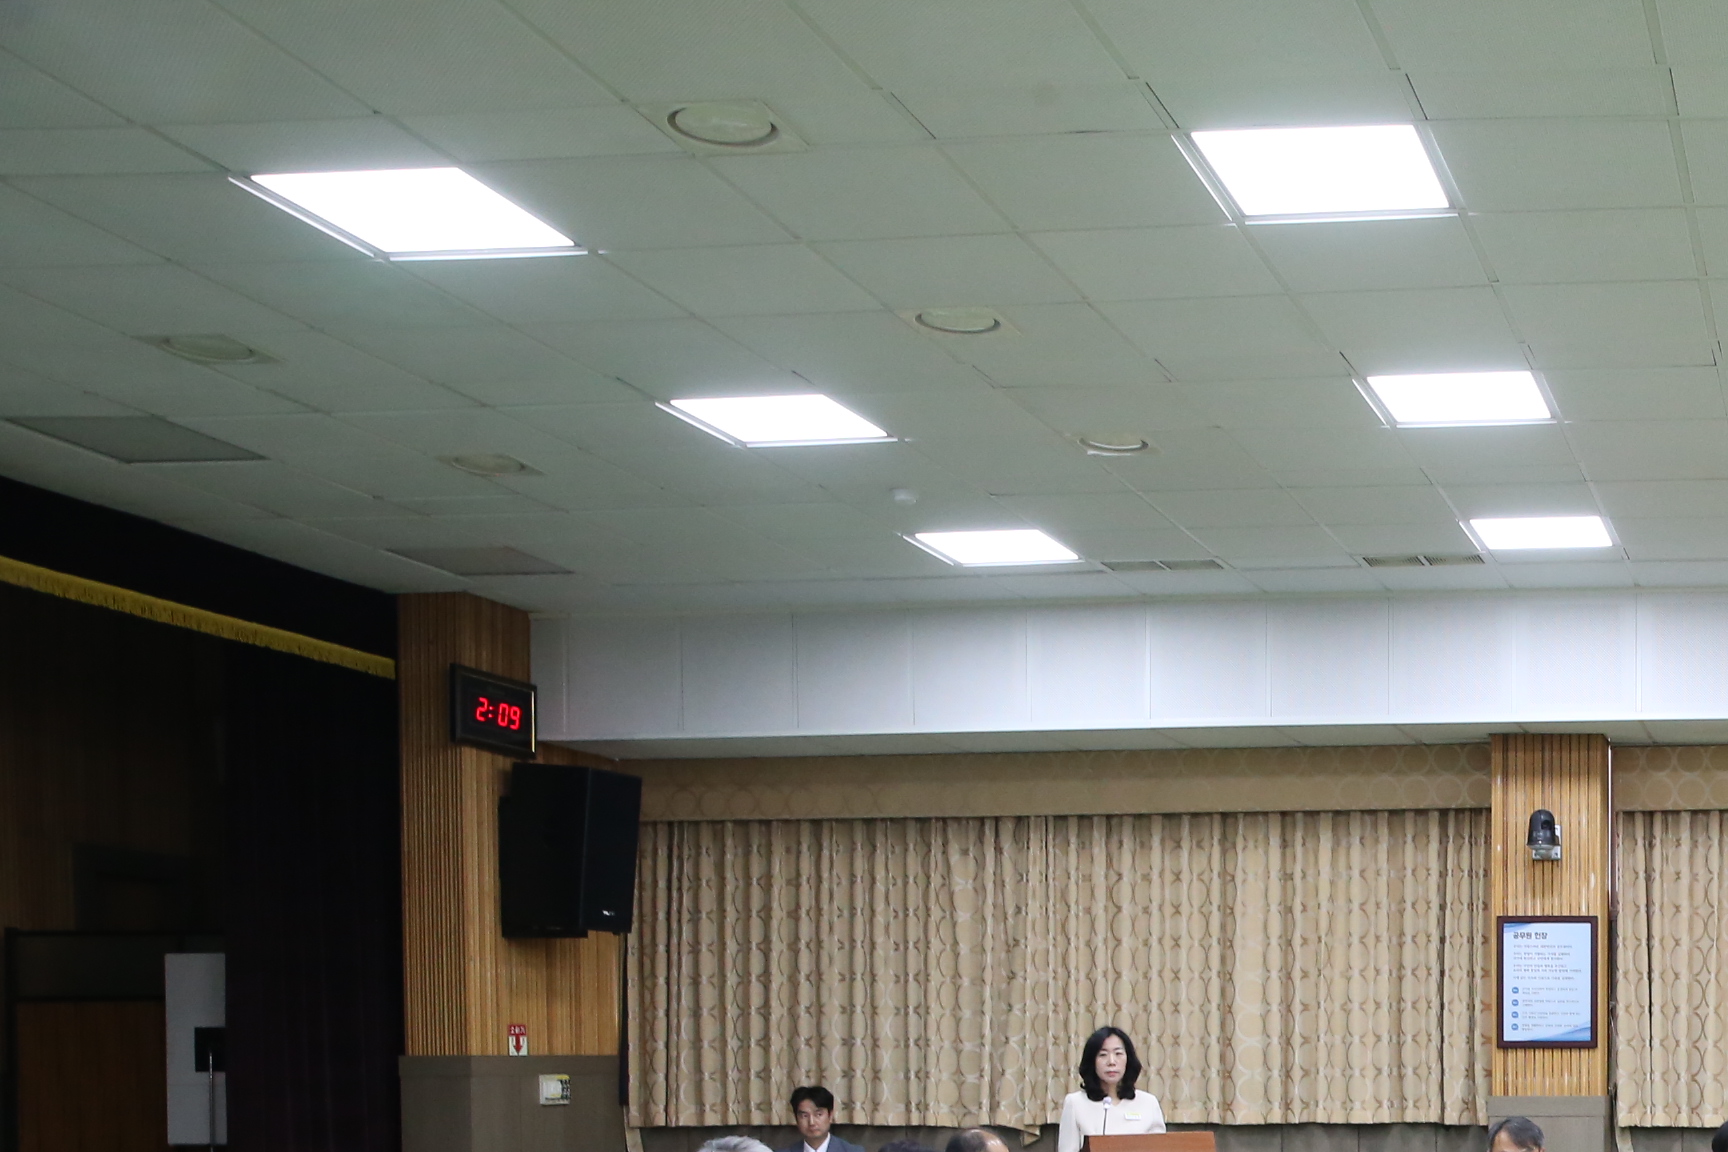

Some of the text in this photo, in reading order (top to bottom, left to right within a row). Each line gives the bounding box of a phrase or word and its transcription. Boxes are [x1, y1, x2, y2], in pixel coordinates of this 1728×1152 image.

[475, 696, 523, 731] 2:09
[1512, 931, 1548, 940] 공무원 헌장
